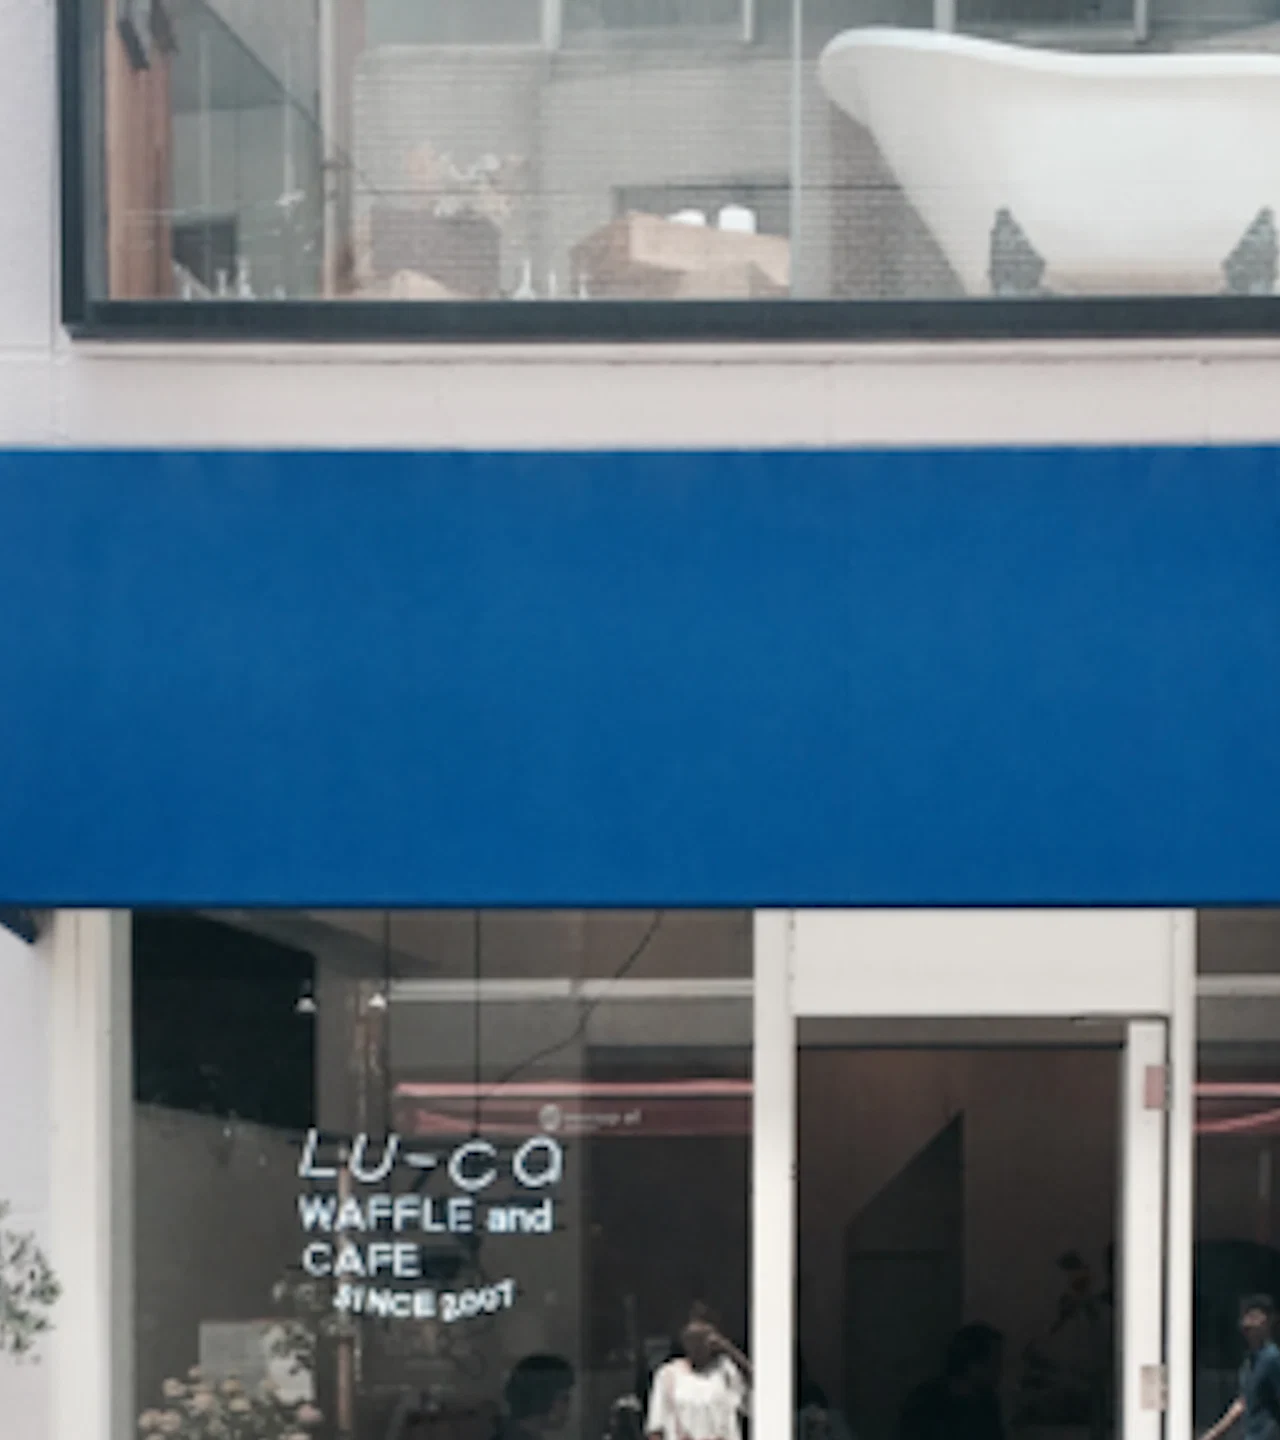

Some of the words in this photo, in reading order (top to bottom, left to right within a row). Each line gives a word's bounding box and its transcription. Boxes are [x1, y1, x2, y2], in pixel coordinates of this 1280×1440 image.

[298, 1194, 474, 1232] WAFFLE
[487, 1198, 553, 1233] and
[302, 1242, 420, 1277] CAFE
[333, 1283, 437, 1318] SINCE
